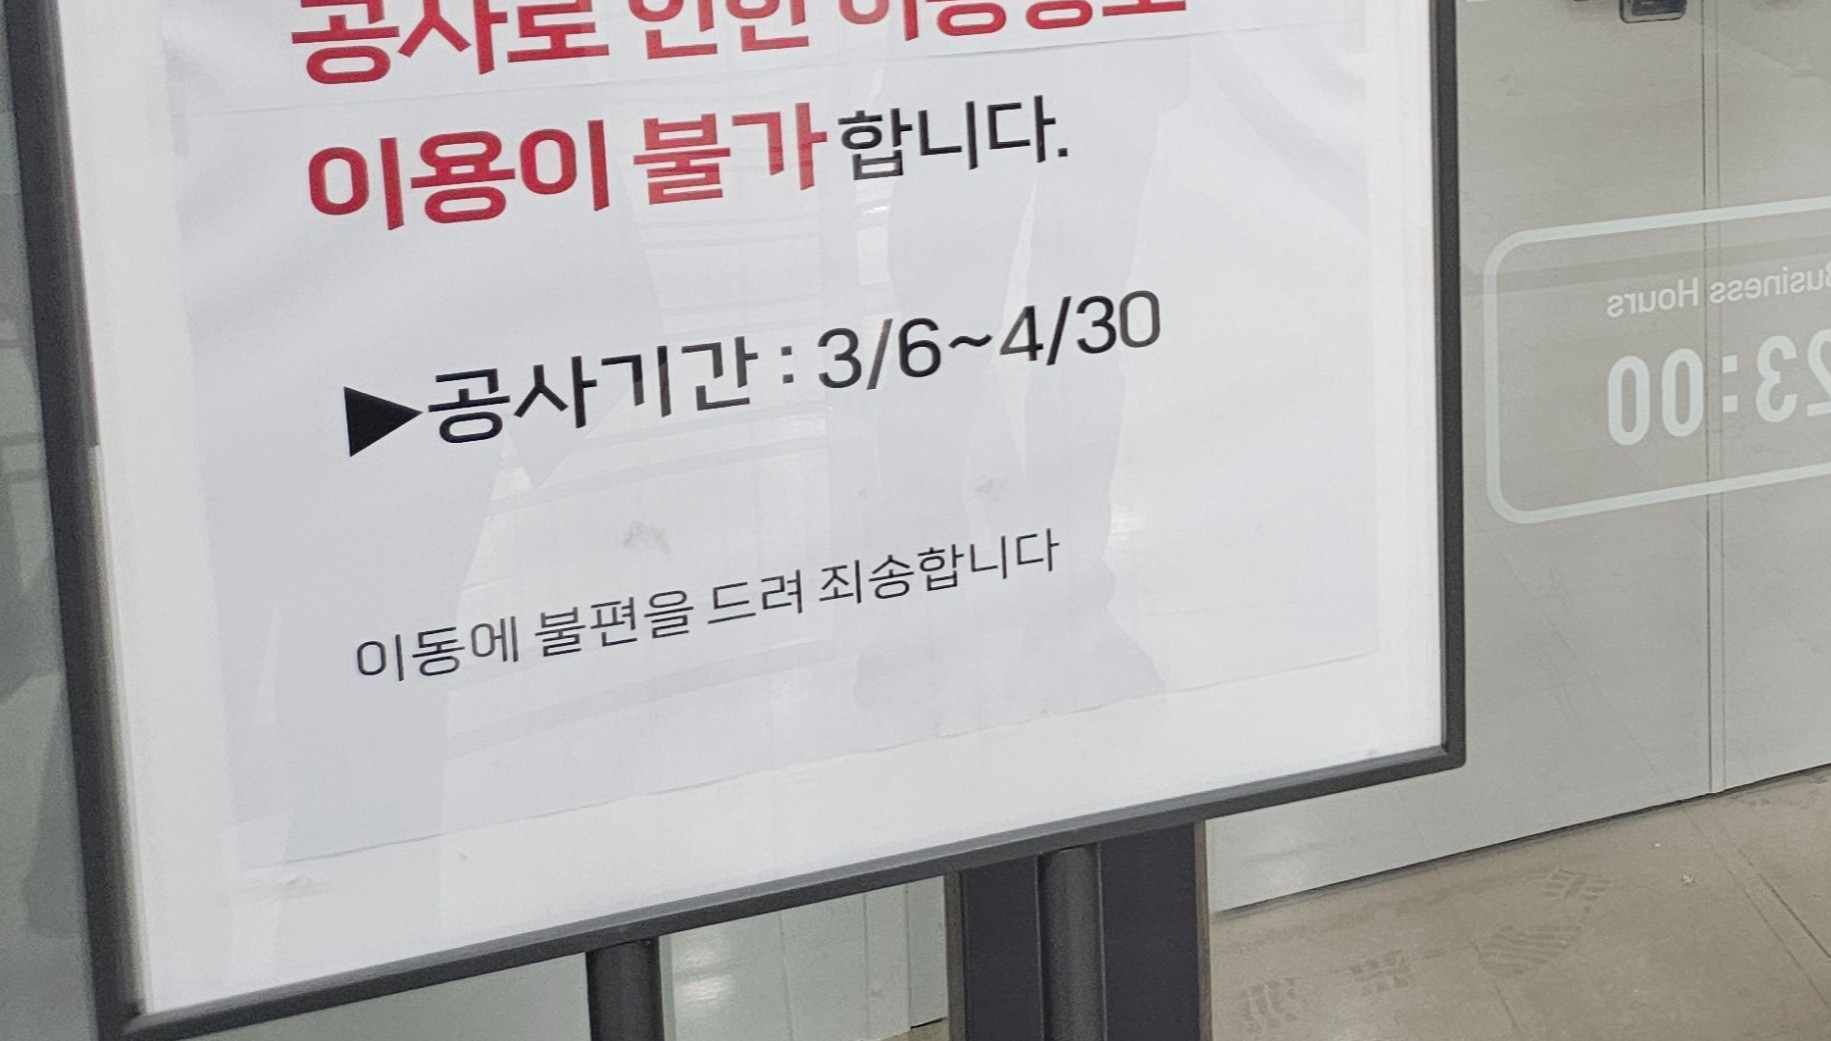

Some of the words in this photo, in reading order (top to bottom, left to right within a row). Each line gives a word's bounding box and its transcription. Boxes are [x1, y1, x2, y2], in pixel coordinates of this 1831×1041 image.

[309, 121, 608, 229] 이용이
[635, 104, 827, 204] 불가
[838, 95, 1067, 180] 합니다.
[428, 337, 758, 443] 공사기간
[818, 291, 1160, 390] 3/6~4/30
[357, 616, 518, 681] 이동에
[535, 591, 693, 657] 불편을
[708, 570, 802, 624] 드려
[819, 529, 1059, 603] 죄송합니다
